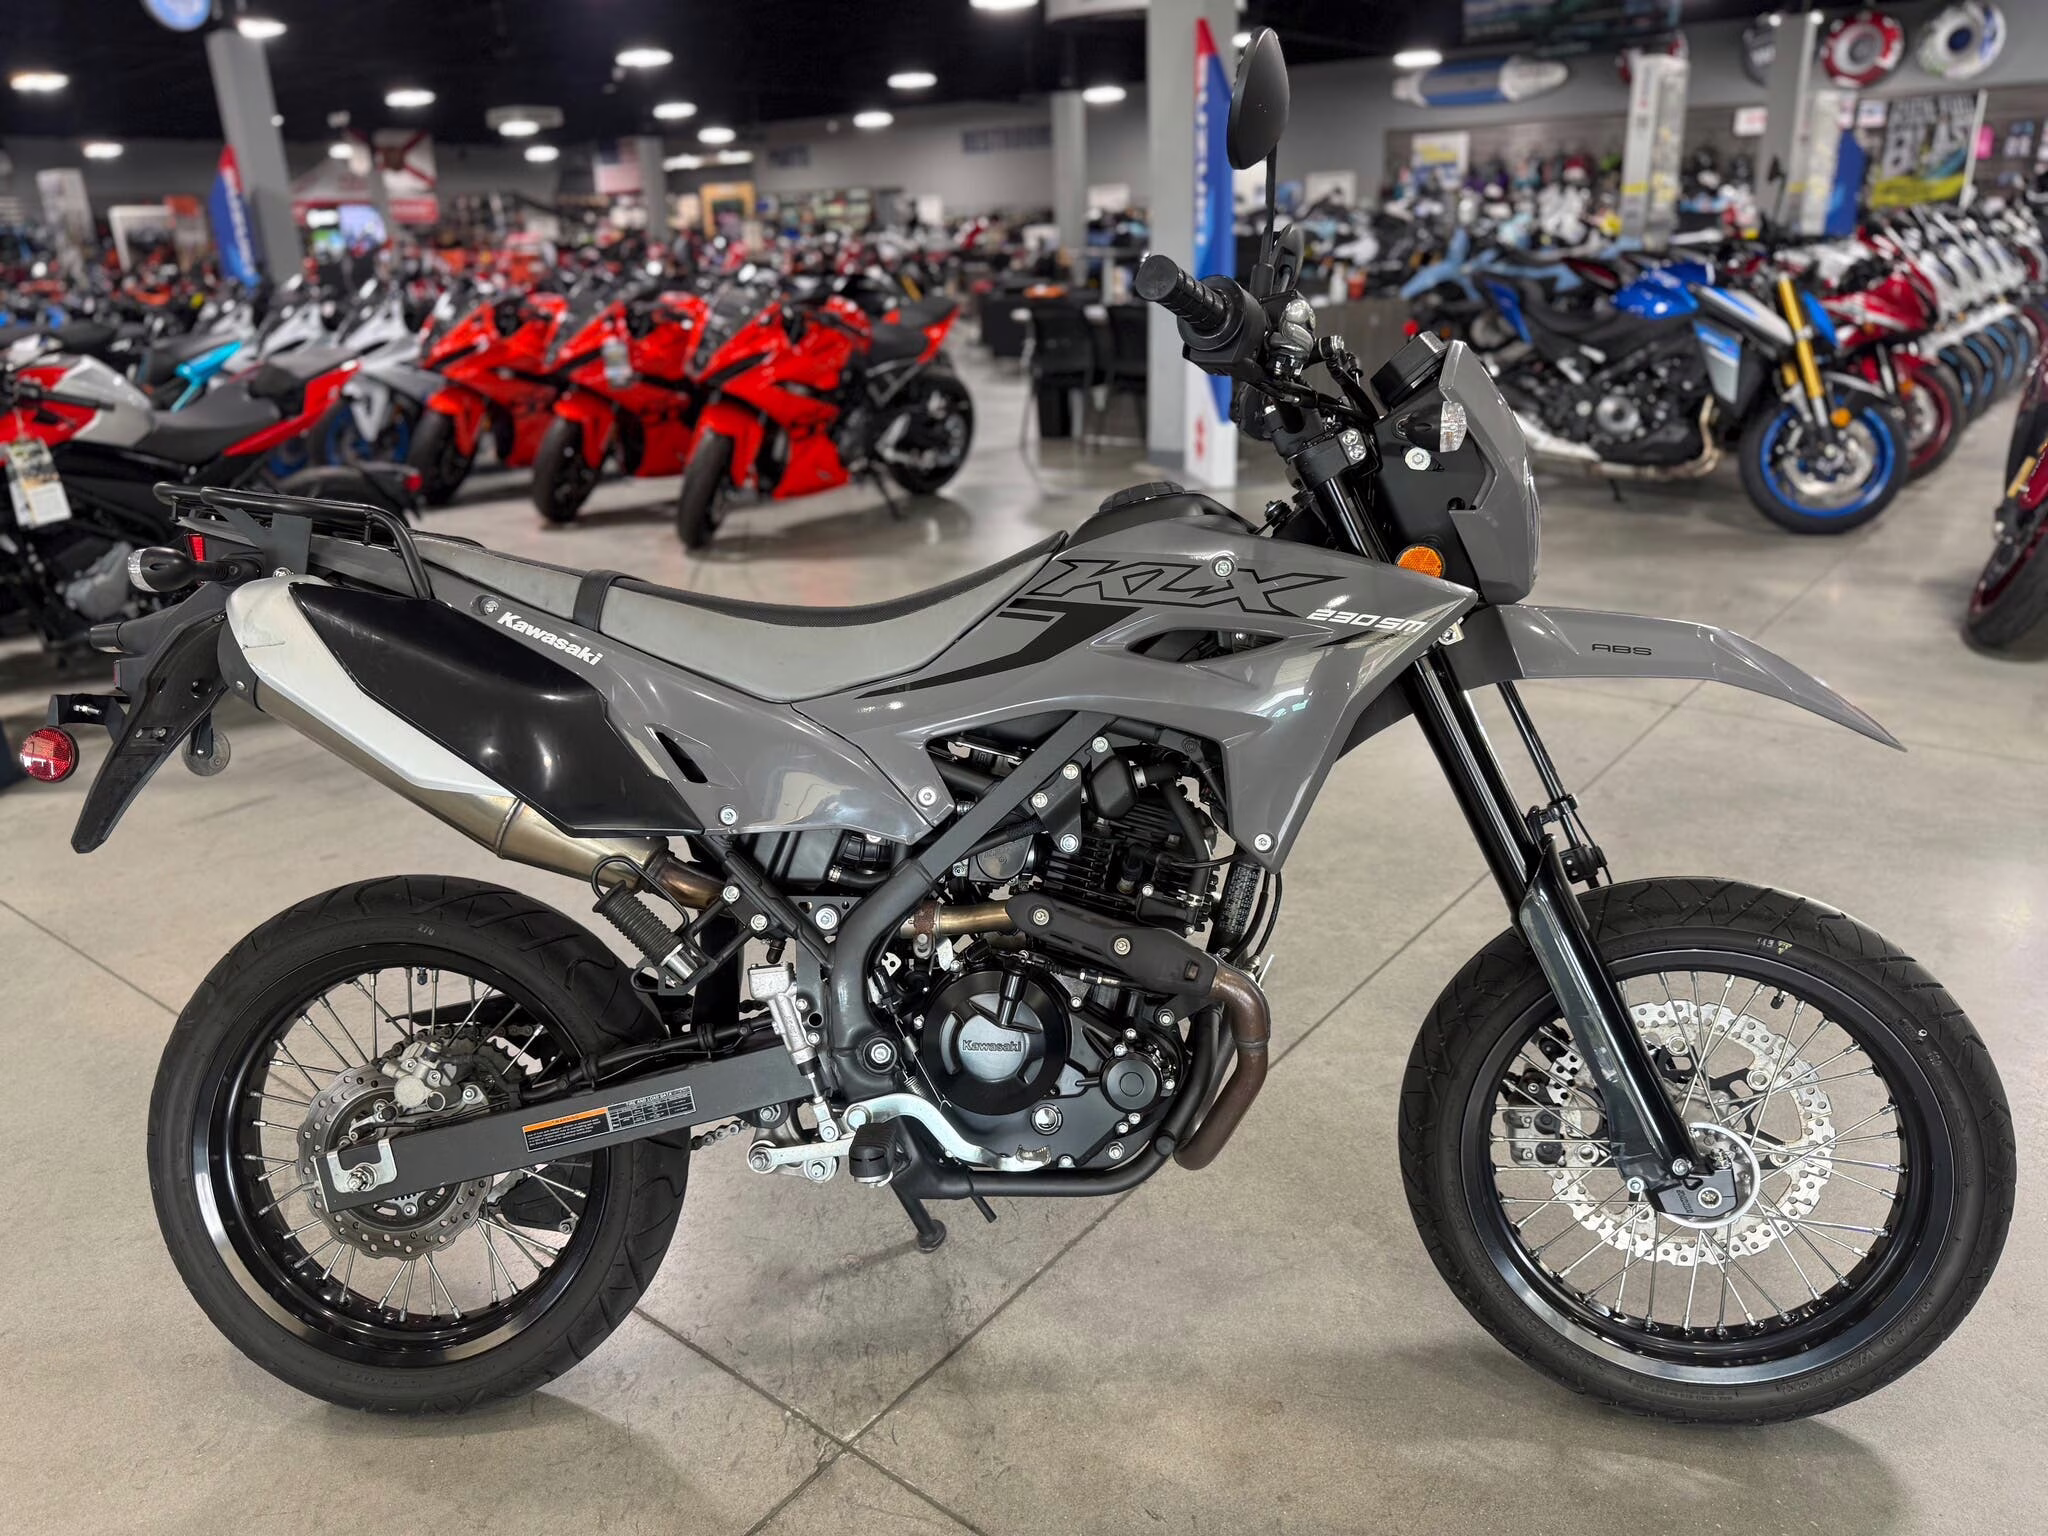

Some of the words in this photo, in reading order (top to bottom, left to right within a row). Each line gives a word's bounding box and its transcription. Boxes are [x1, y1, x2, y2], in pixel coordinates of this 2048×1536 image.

[1026, 558, 1349, 618] KLX
[497, 611, 604, 666] Kawasaki
[1591, 643, 1652, 656] ABS
[962, 1039, 1022, 1052] Kawasaki
